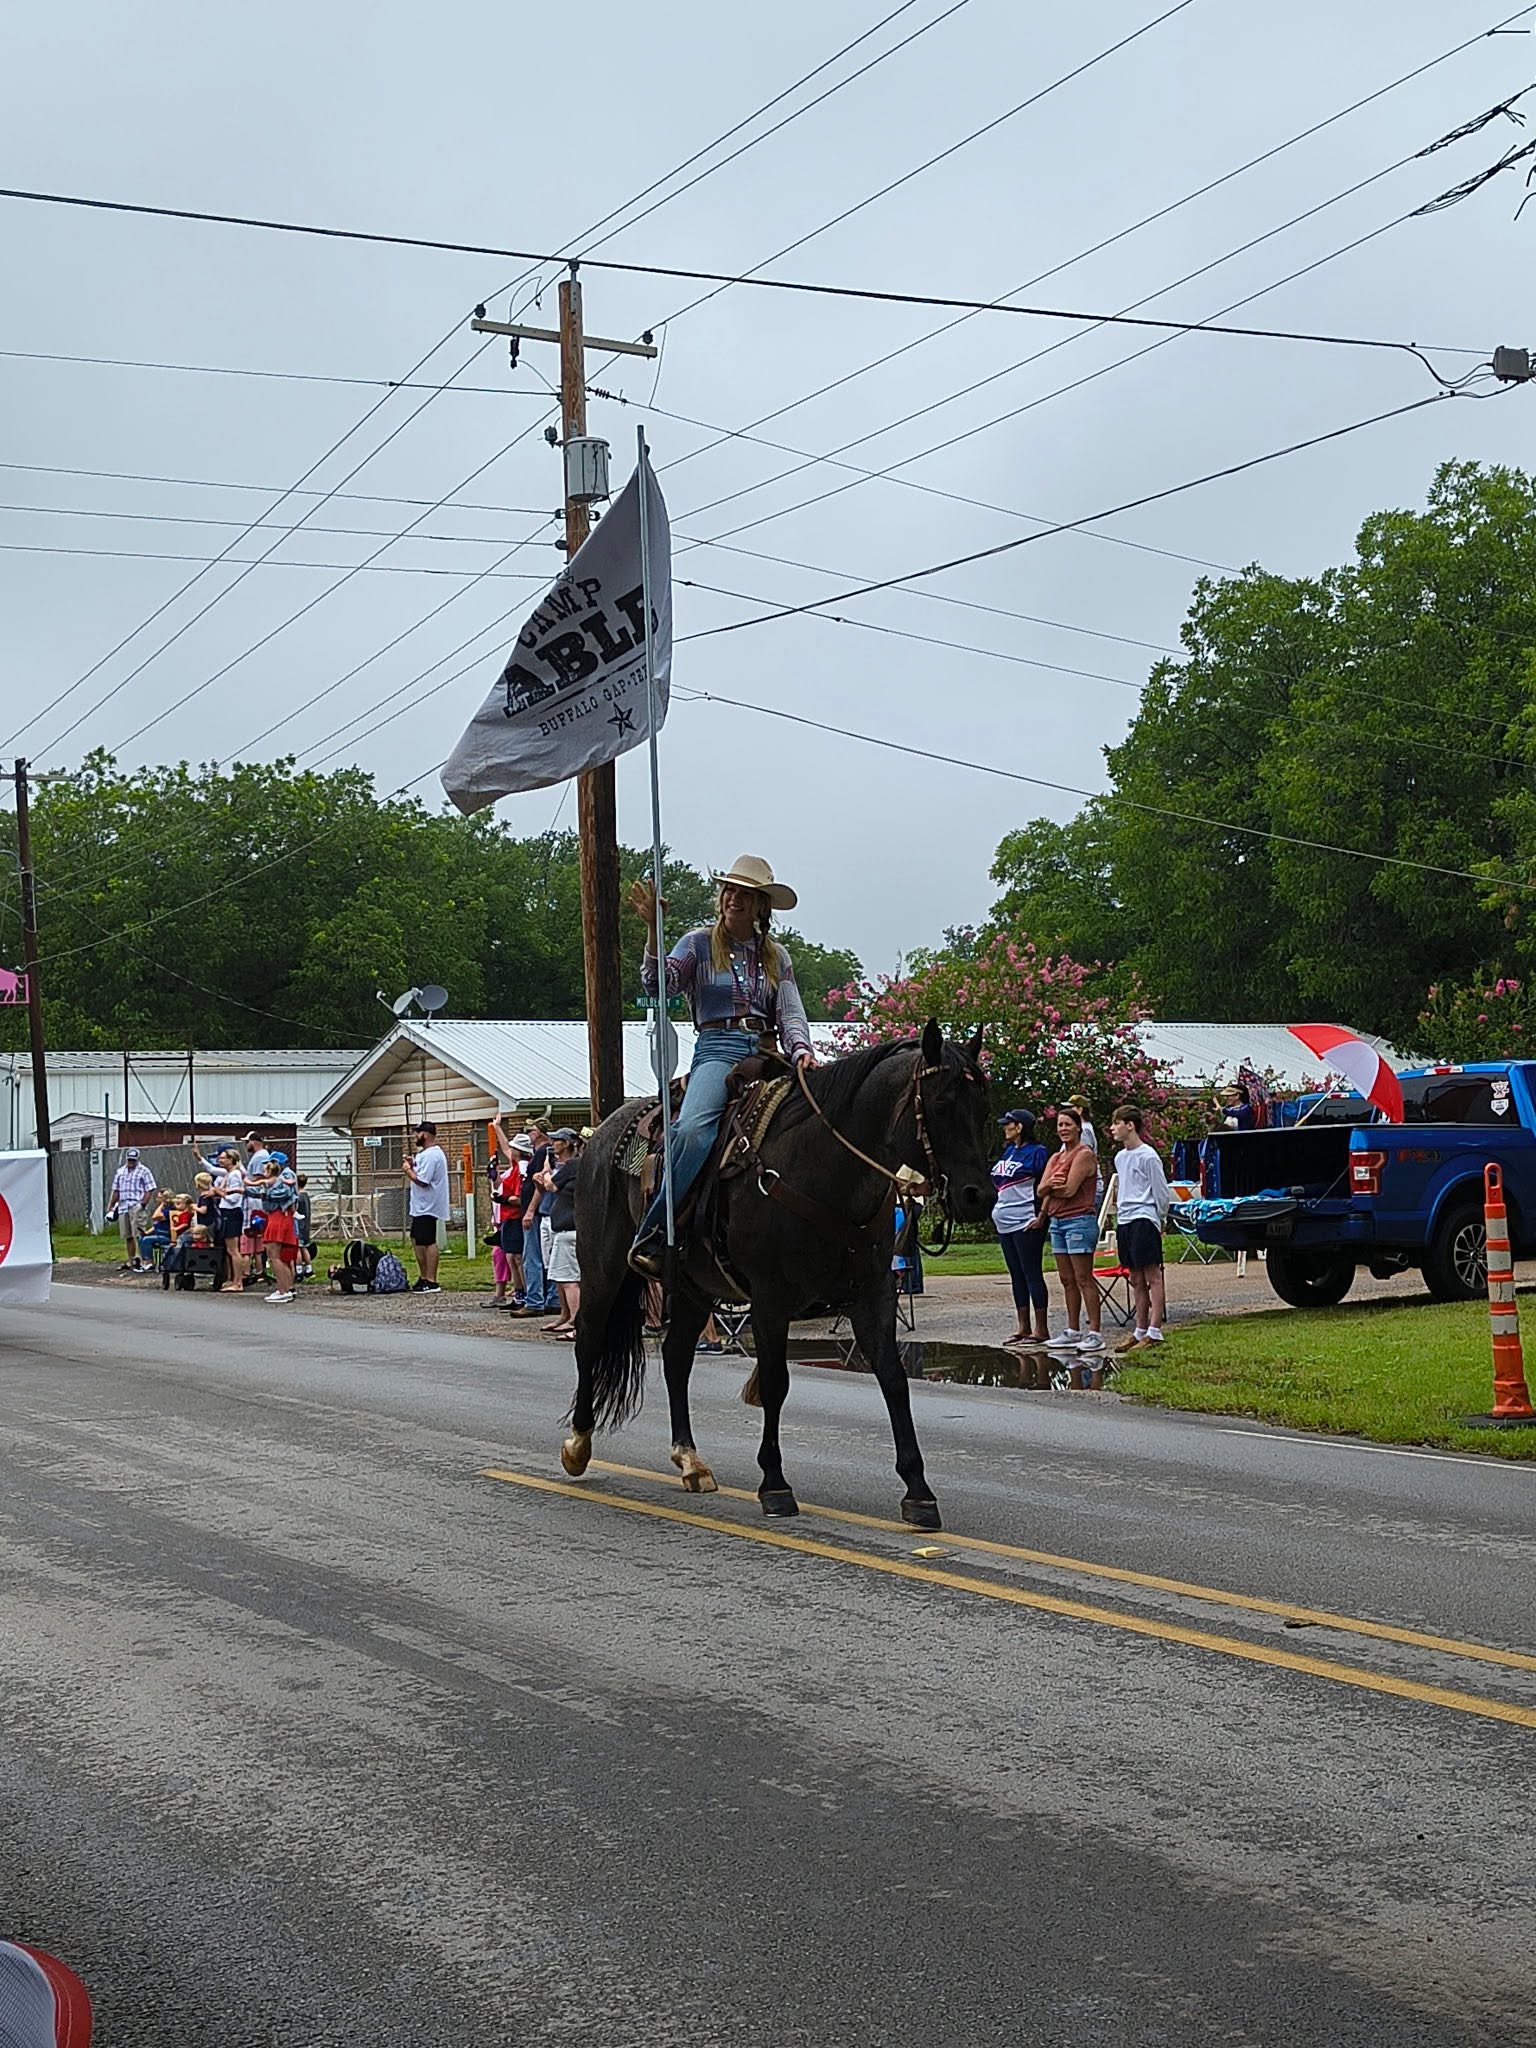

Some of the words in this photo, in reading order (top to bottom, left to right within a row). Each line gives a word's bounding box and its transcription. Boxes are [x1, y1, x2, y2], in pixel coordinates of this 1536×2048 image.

[518, 578, 602, 649] CAMP
[503, 584, 659, 719] ABLE
[538, 696, 599, 736] BUFFALO
[636, 996, 671, 1008] MULBEY
